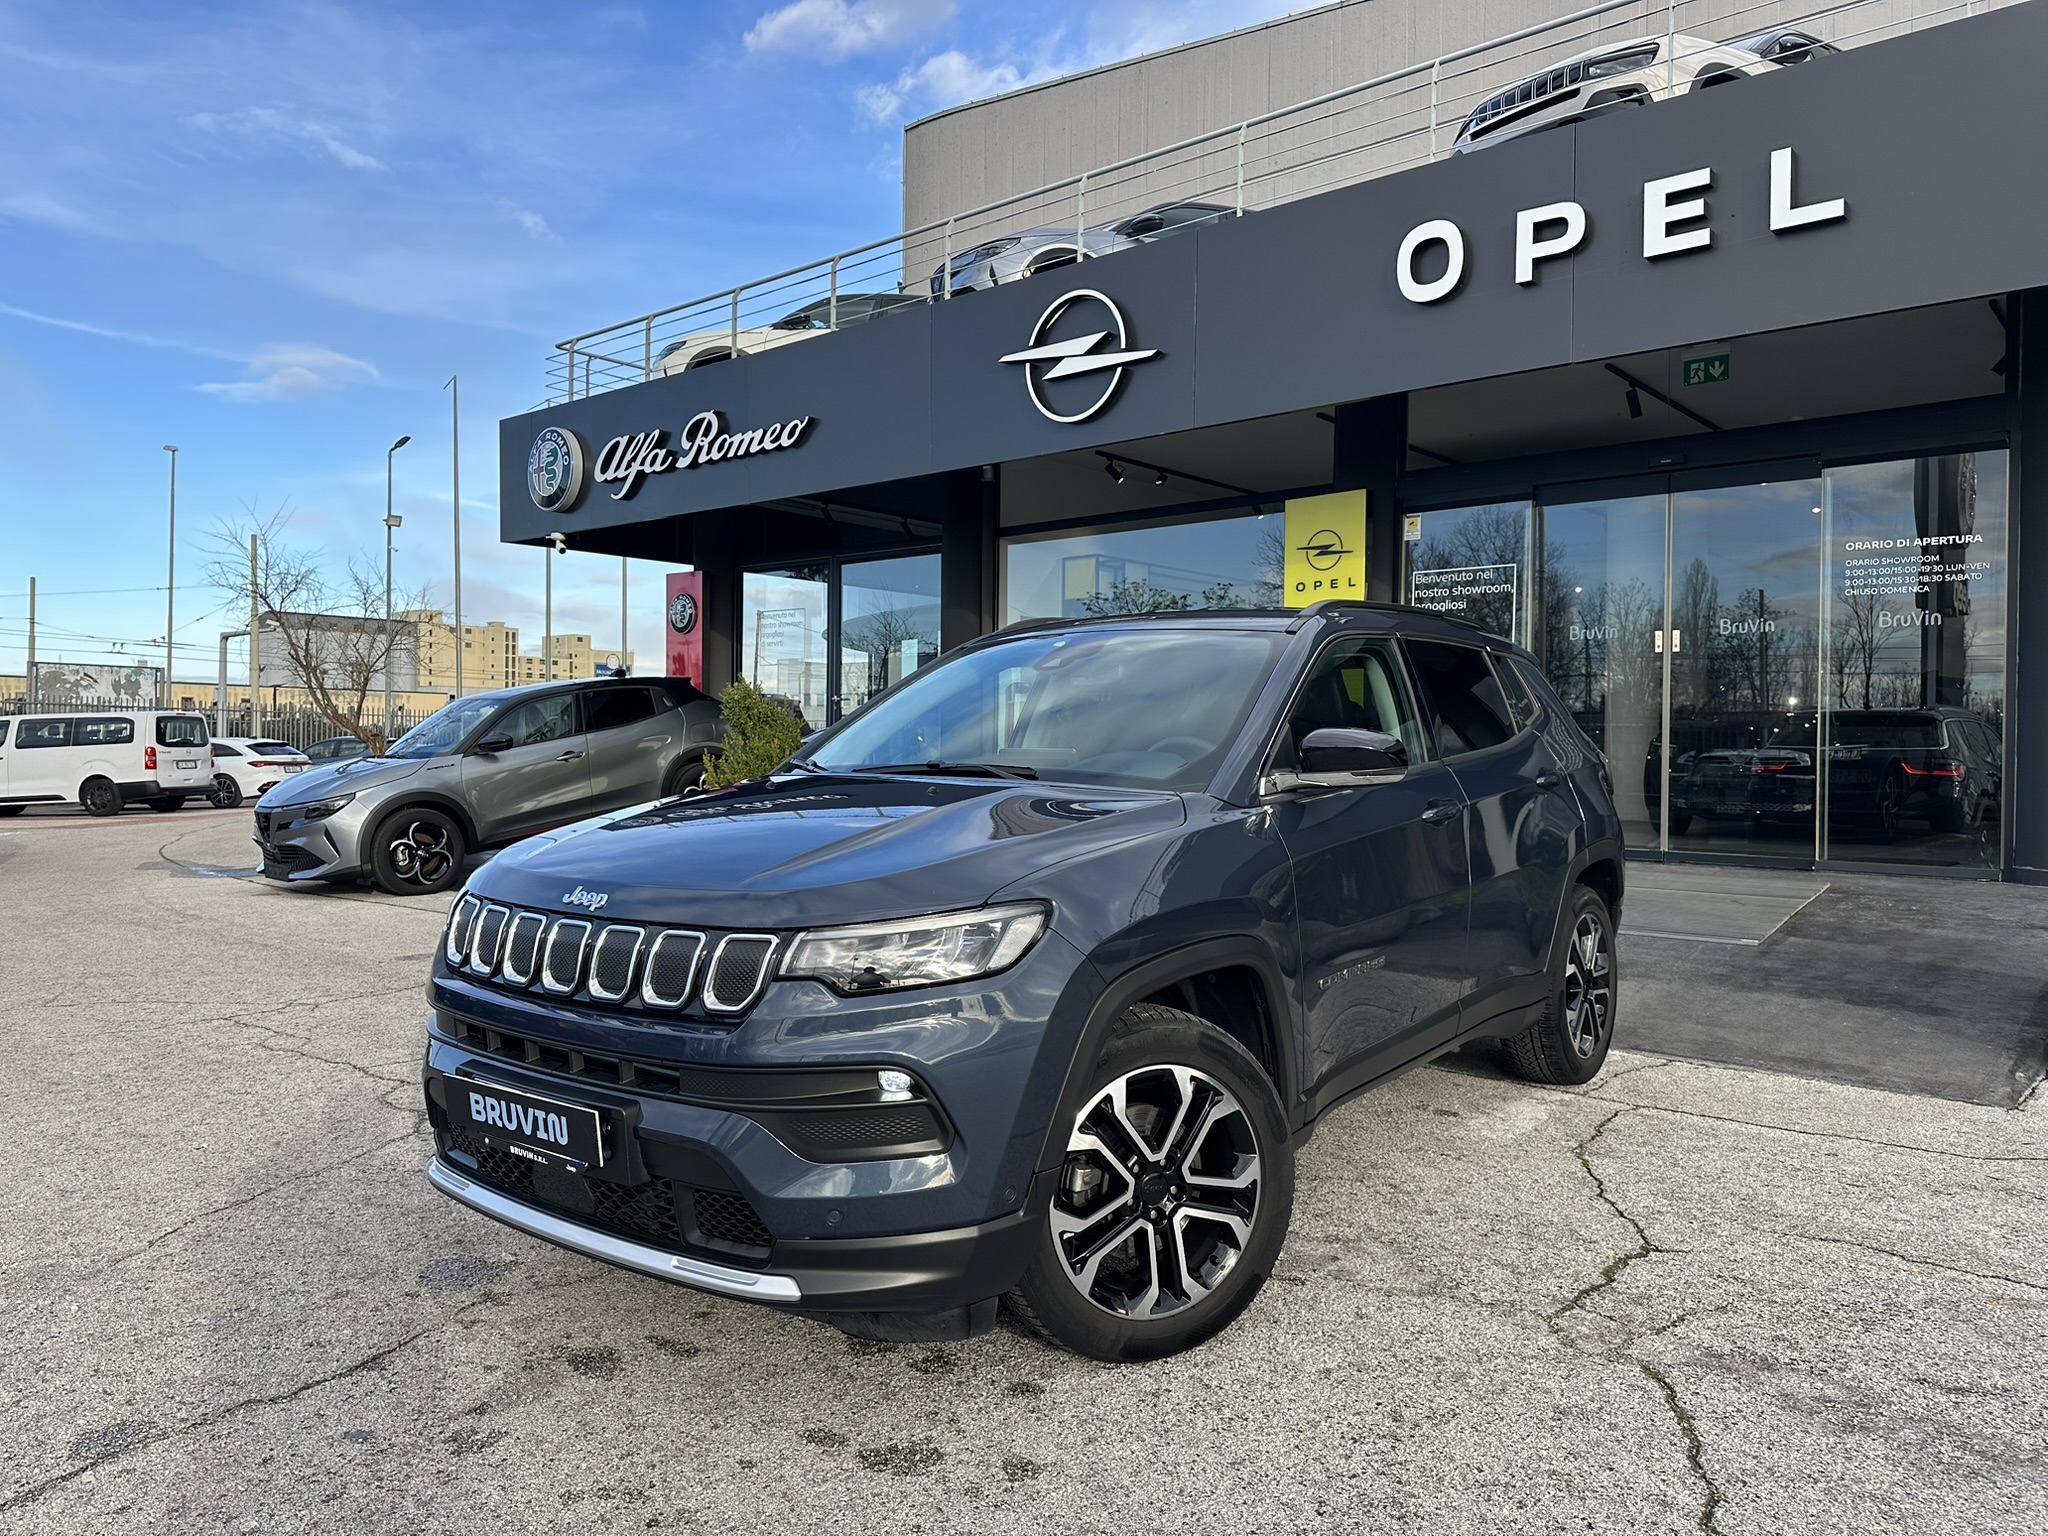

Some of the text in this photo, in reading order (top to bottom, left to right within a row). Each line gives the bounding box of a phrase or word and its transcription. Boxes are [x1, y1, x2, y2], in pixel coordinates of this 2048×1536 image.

[1396, 146, 1846, 303] OPEL
[545, 432, 570, 466] ROMEO
[594, 410, 809, 500] Alfa Romeo
[1845, 534, 1983, 551] ORARIO DI APERTURA
[1845, 555, 1940, 567] ORARIO SHOWROOM
[1946, 562, 1991, 571] LUN-VEN
[1295, 577, 1356, 592] OPEL
[1415, 569, 1493, 584] Benvenuto nel
[1944, 573, 1983, 582] SABATO
[1415, 584, 1514, 598] nostro showroom,
[1844, 585, 1931, 596] CHIUSO DOMENICA
[1719, 618, 1775, 635] BruVin
[1879, 610, 1942, 628] BruVin
[1569, 625, 1618, 641] BruVin
[562, 885, 609, 912] Jeep
[469, 1091, 569, 1146] BRUVIN
[509, 1145, 534, 1160] BRUVIN
